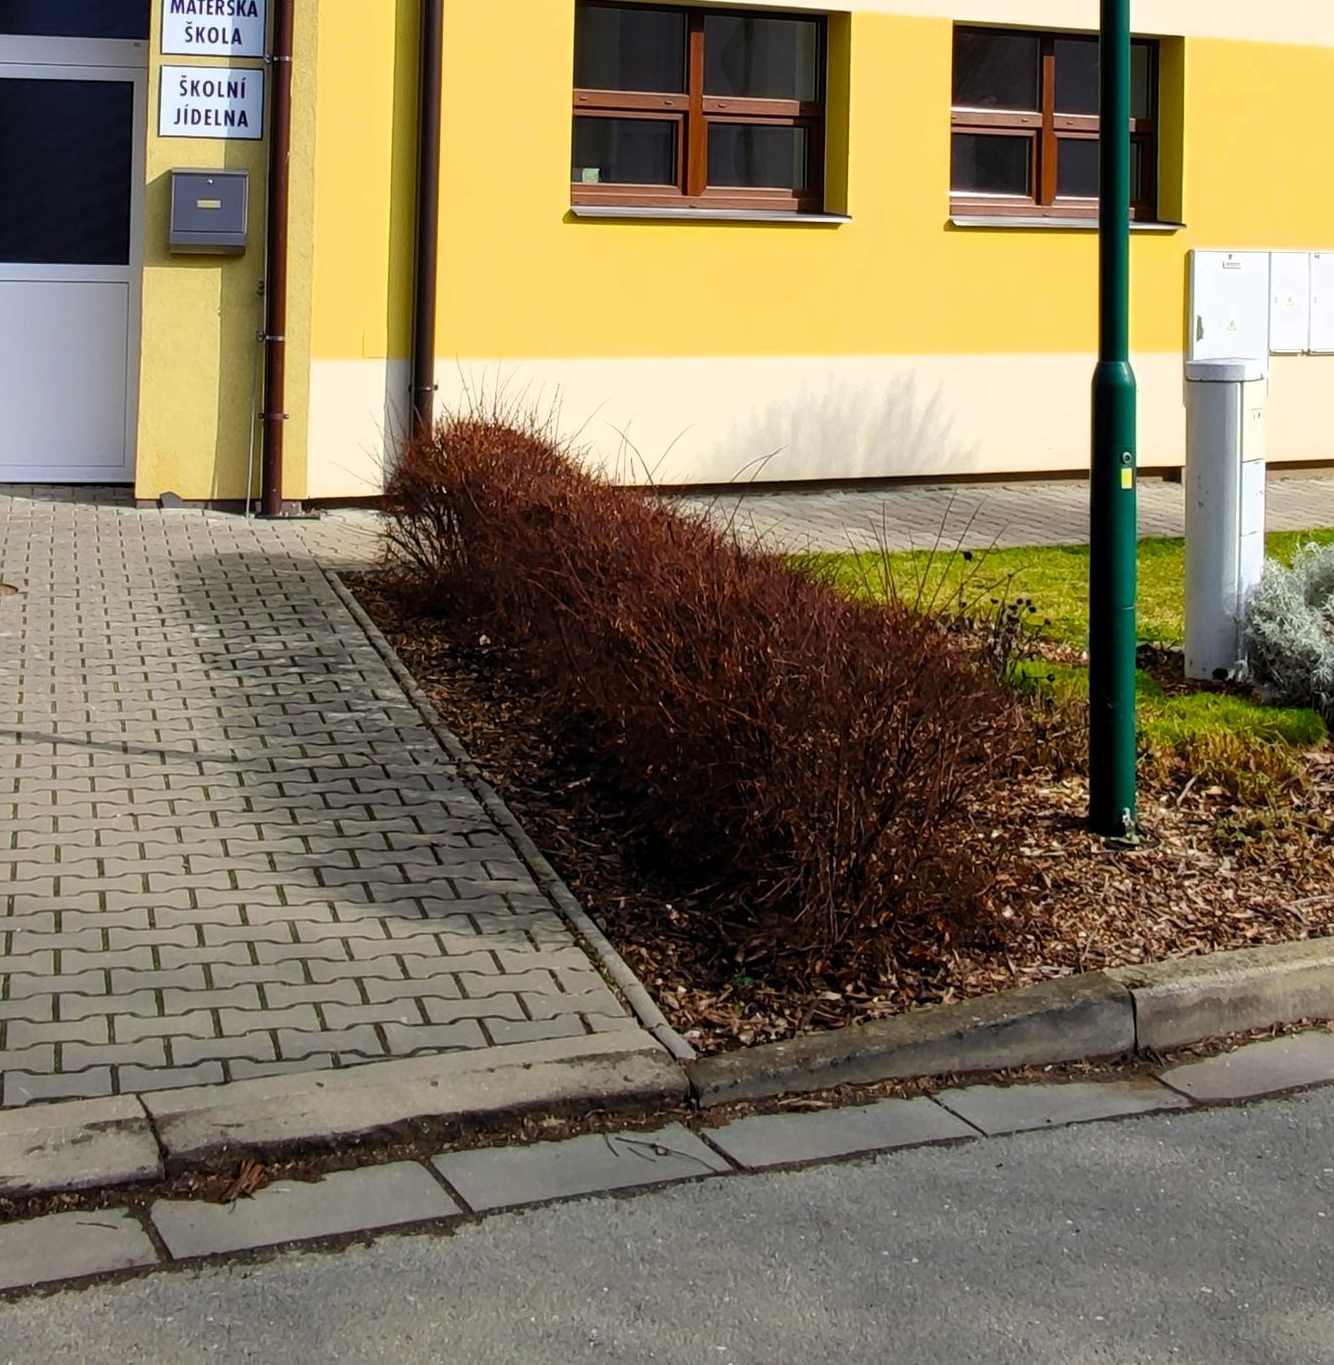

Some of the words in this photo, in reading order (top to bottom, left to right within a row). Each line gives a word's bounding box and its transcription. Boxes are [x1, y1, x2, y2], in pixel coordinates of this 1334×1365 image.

[185, 21, 243, 45] ŠKOLA
[179, 75, 246, 99] ŠKOLNÍ
[173, 104, 249, 127] JÍDELNA
